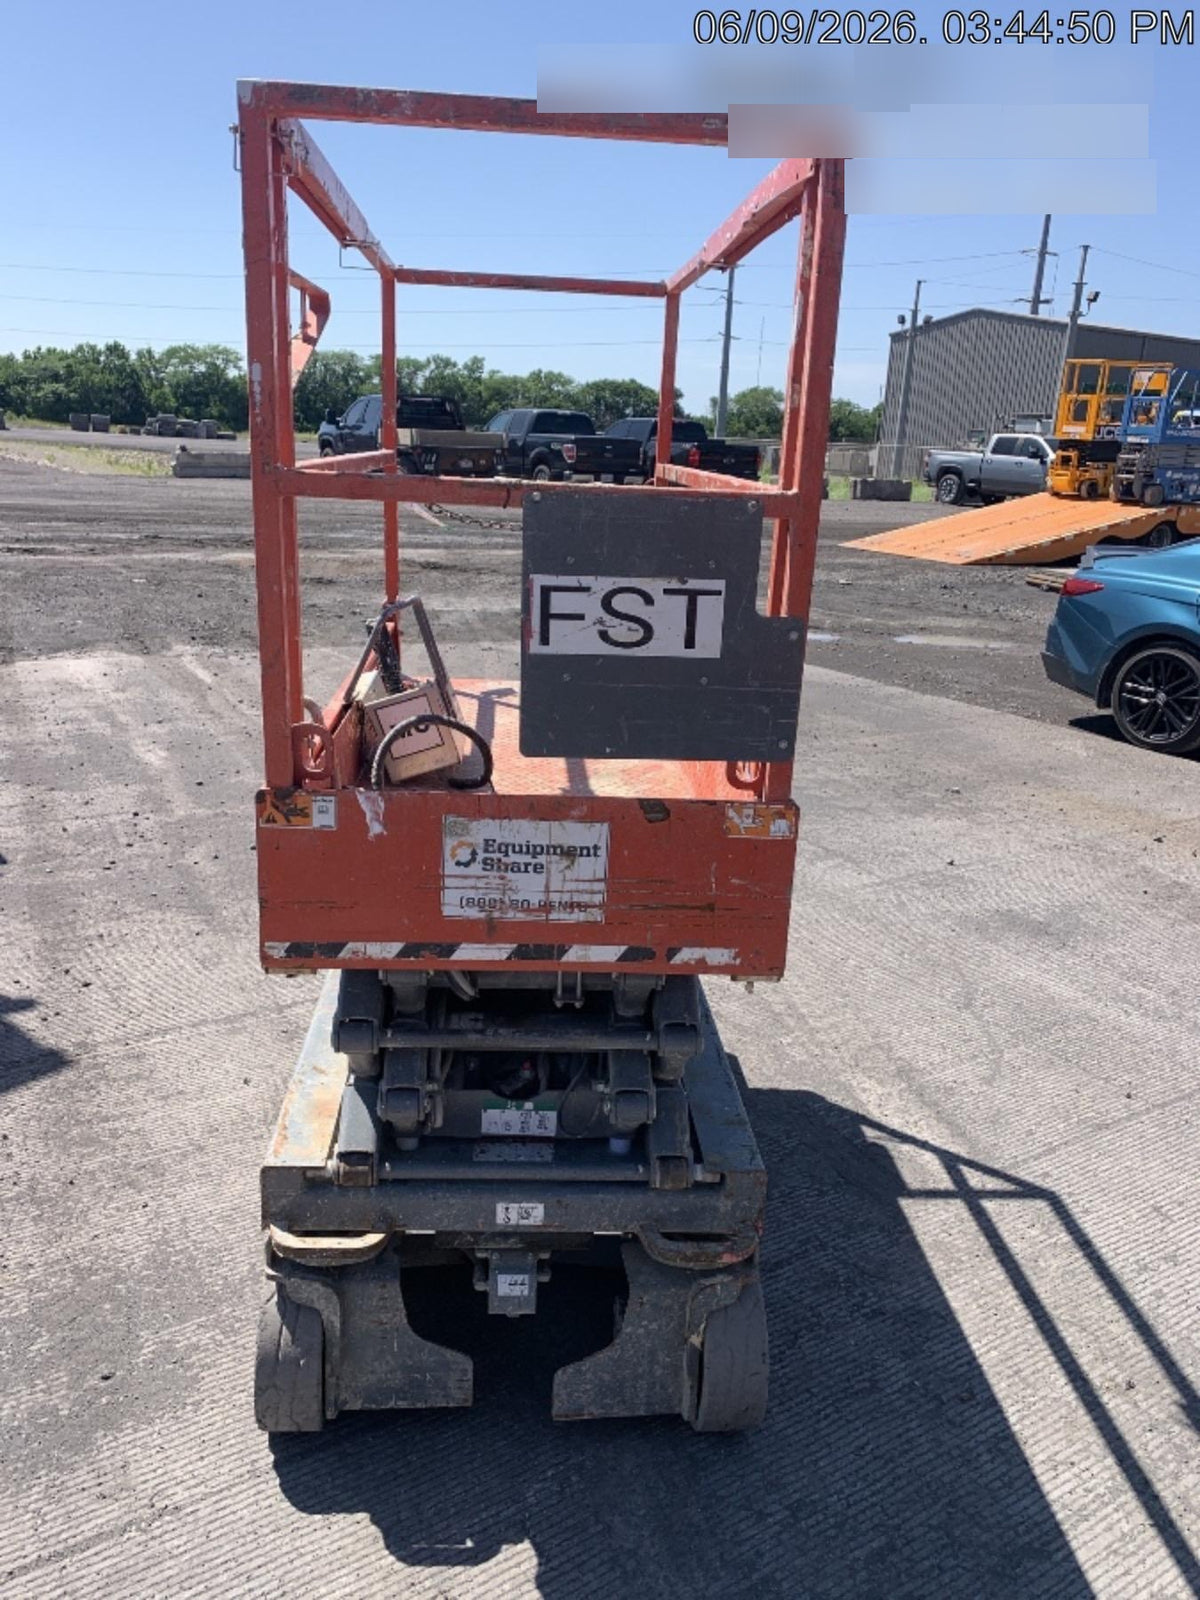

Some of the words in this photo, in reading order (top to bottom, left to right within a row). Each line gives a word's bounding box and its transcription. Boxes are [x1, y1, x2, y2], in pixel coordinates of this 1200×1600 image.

[538, 584, 723, 650] FST
[482, 838, 602, 859] Equipment
[481, 856, 546, 875] Share
